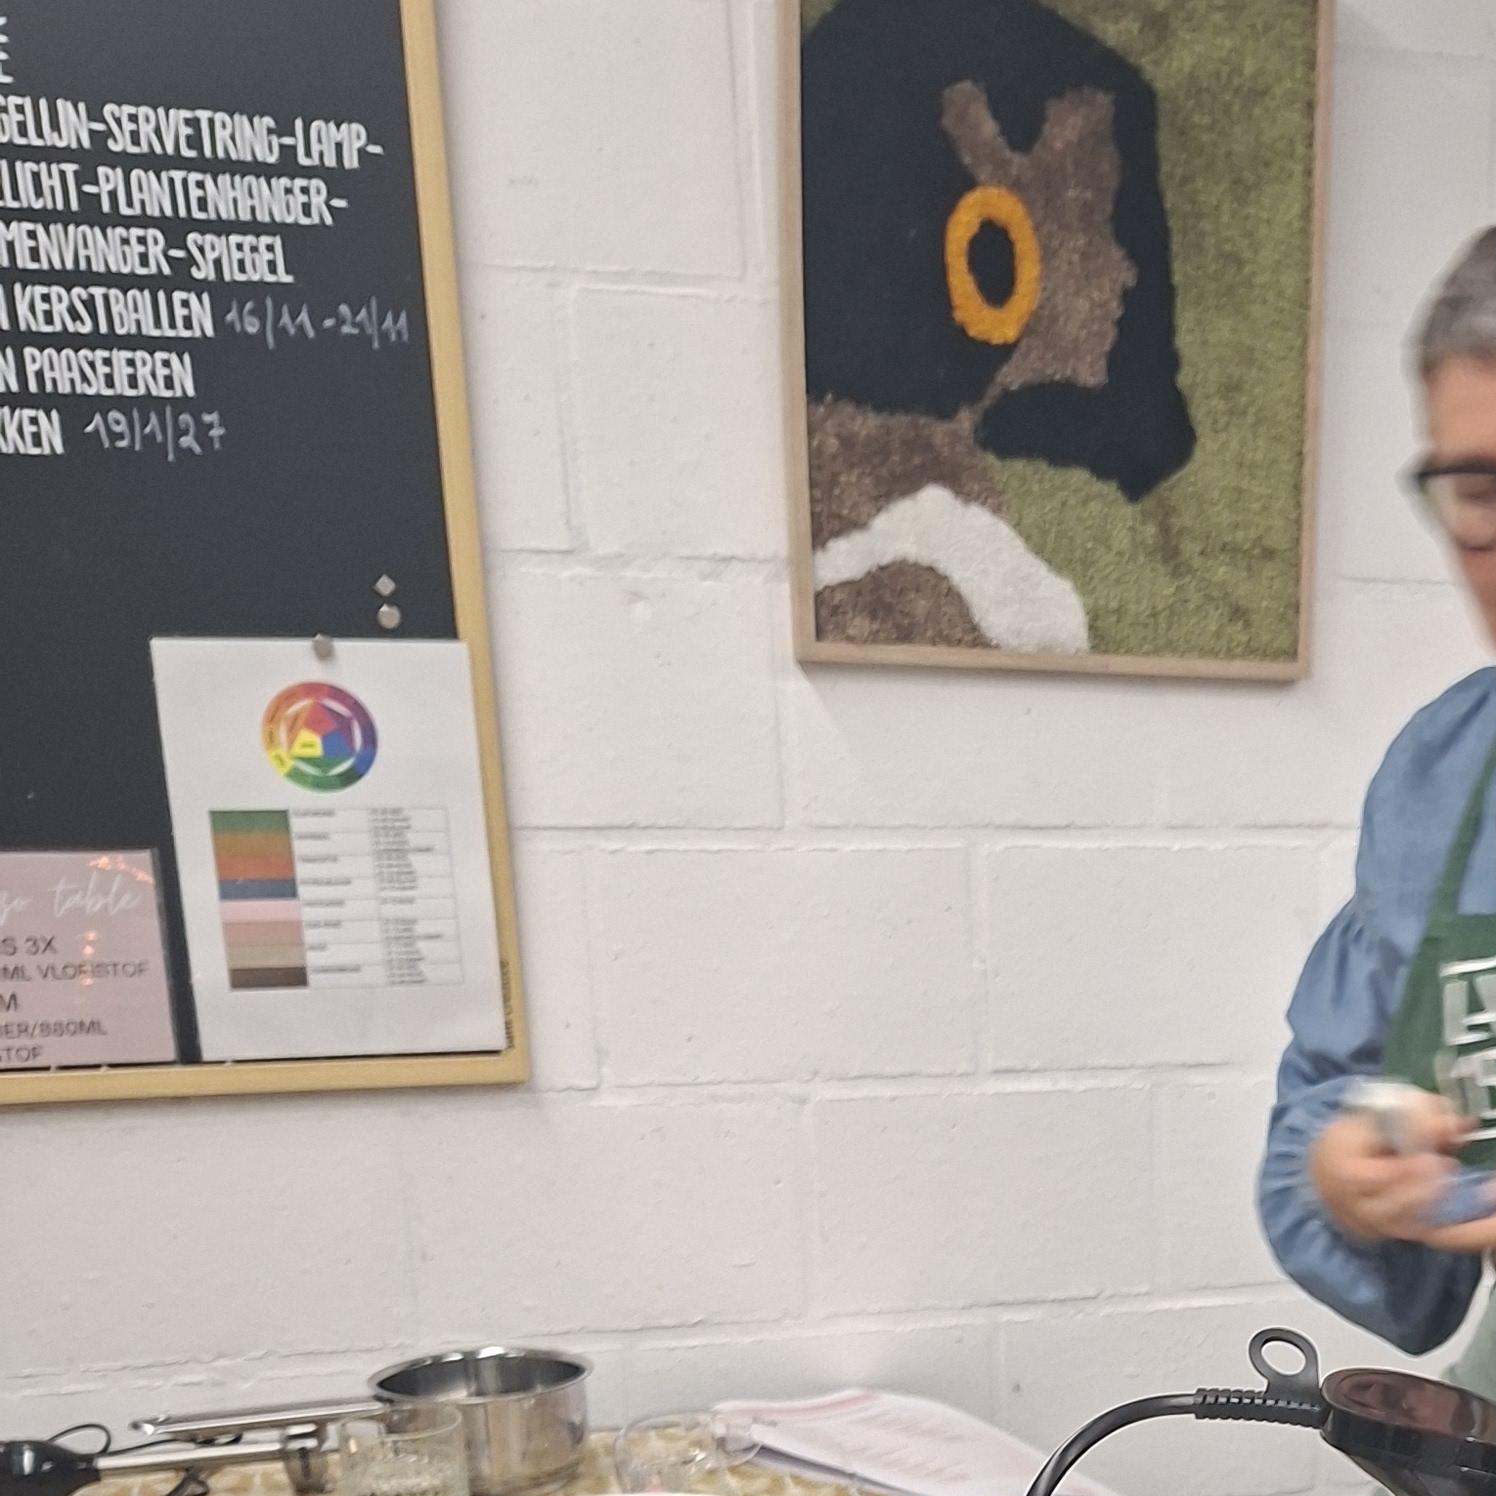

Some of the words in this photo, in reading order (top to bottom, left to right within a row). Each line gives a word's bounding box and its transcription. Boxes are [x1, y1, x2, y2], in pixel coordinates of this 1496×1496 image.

[0, 159, 348, 226] LICHT-PLANTENHANGER-
[13, 281, 214, 338] KERSTBALLEN
[23, 346, 195, 398] PAASEIEREN
[84, 404, 226, 462] 19/1/27
